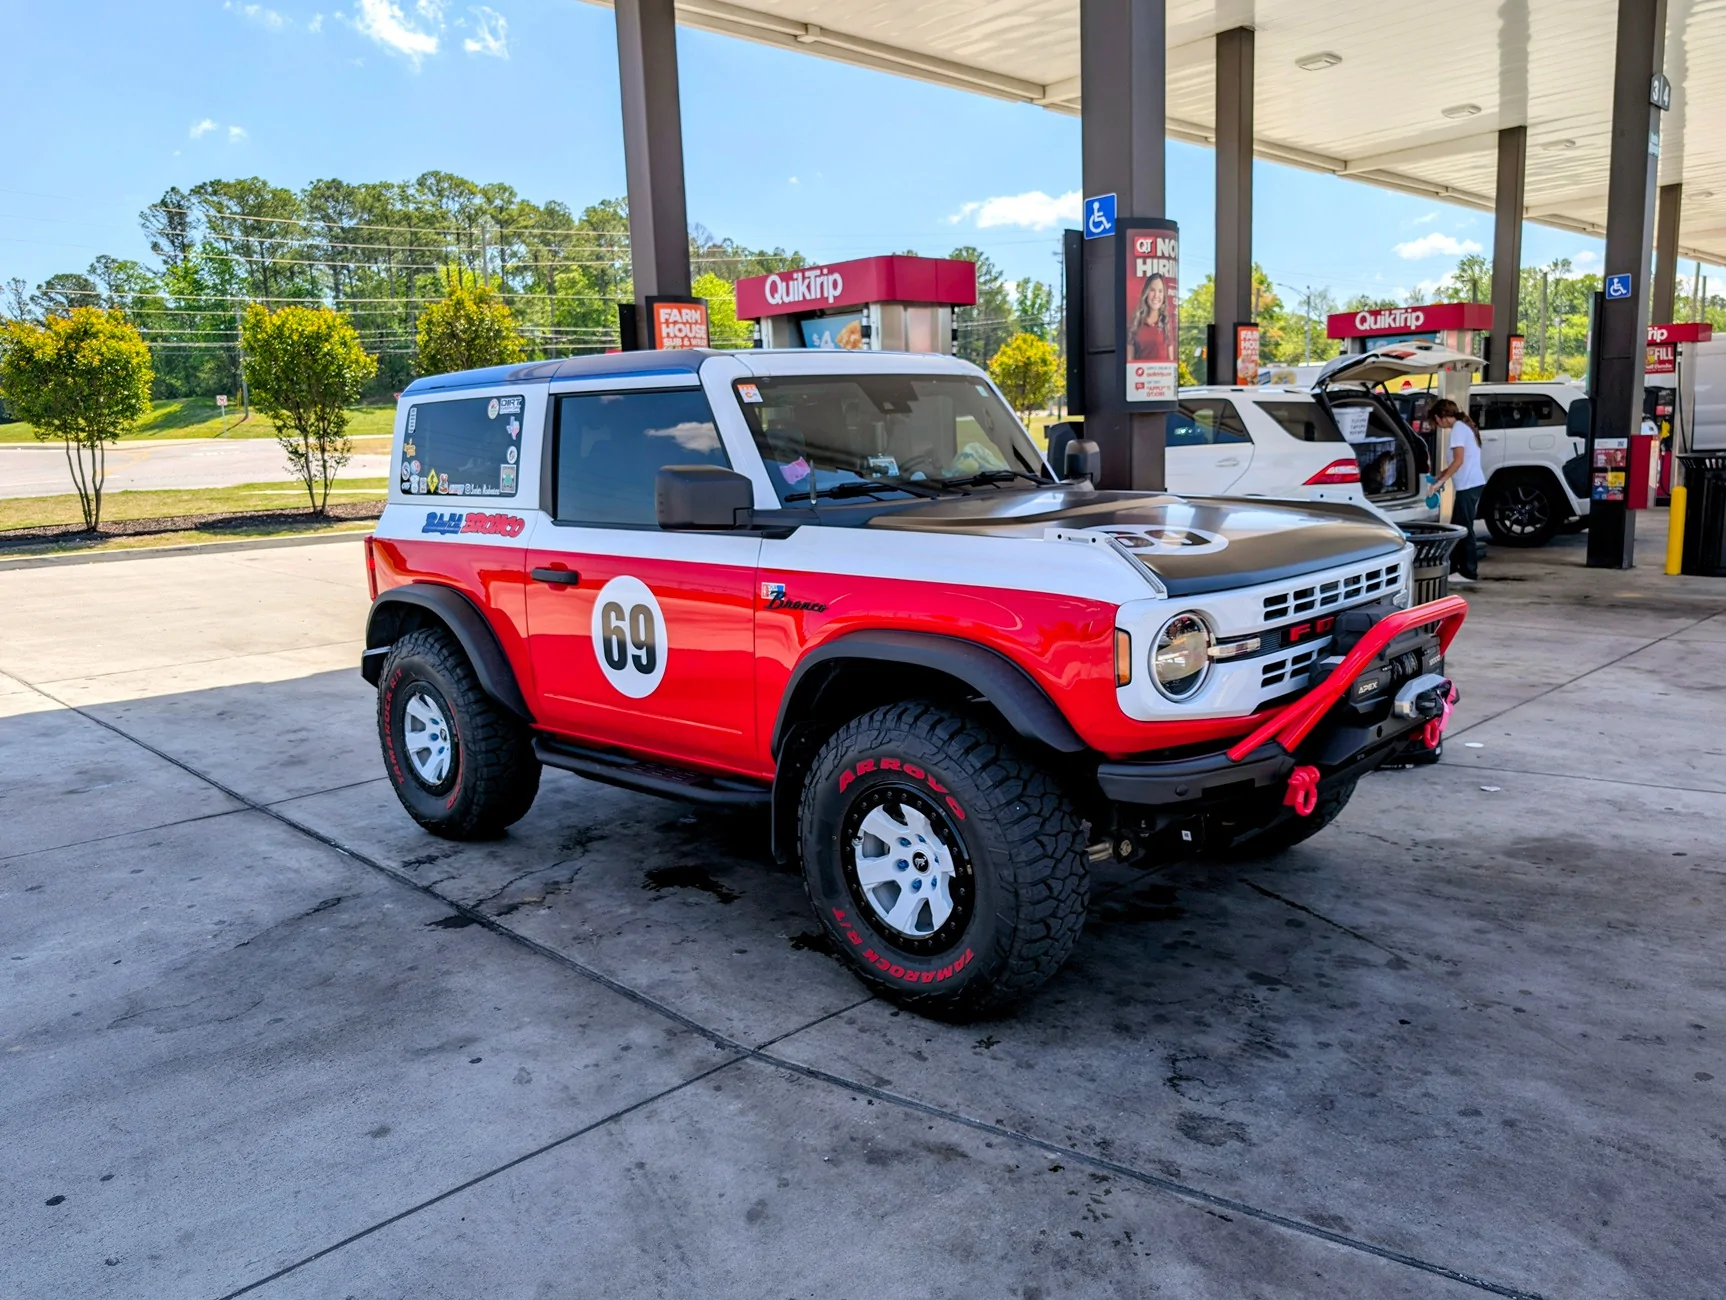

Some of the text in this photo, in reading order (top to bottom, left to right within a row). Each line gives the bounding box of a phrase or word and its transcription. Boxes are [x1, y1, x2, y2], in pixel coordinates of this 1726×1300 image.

[1652, 80, 1670, 106] 3 4
[1136, 237, 1178, 259] QT NO
[1136, 258, 1177, 278] HIRI
[764, 267, 844, 305] QuikTrip
[660, 308, 701, 323] FARM
[1355, 309, 1424, 331] QuikTrip
[661, 323, 707, 338] HOUSE
[1647, 326, 1668, 342] rip
[1654, 347, 1674, 360] FILL
[460, 512, 525, 538] BRONCO
[764, 591, 828, 613] Bronco
[601, 601, 657, 675] 69
[1358, 681, 1378, 694] APEX
[839, 757, 966, 820] ARROYO
[832, 907, 975, 984] TAMAROCK R/T
